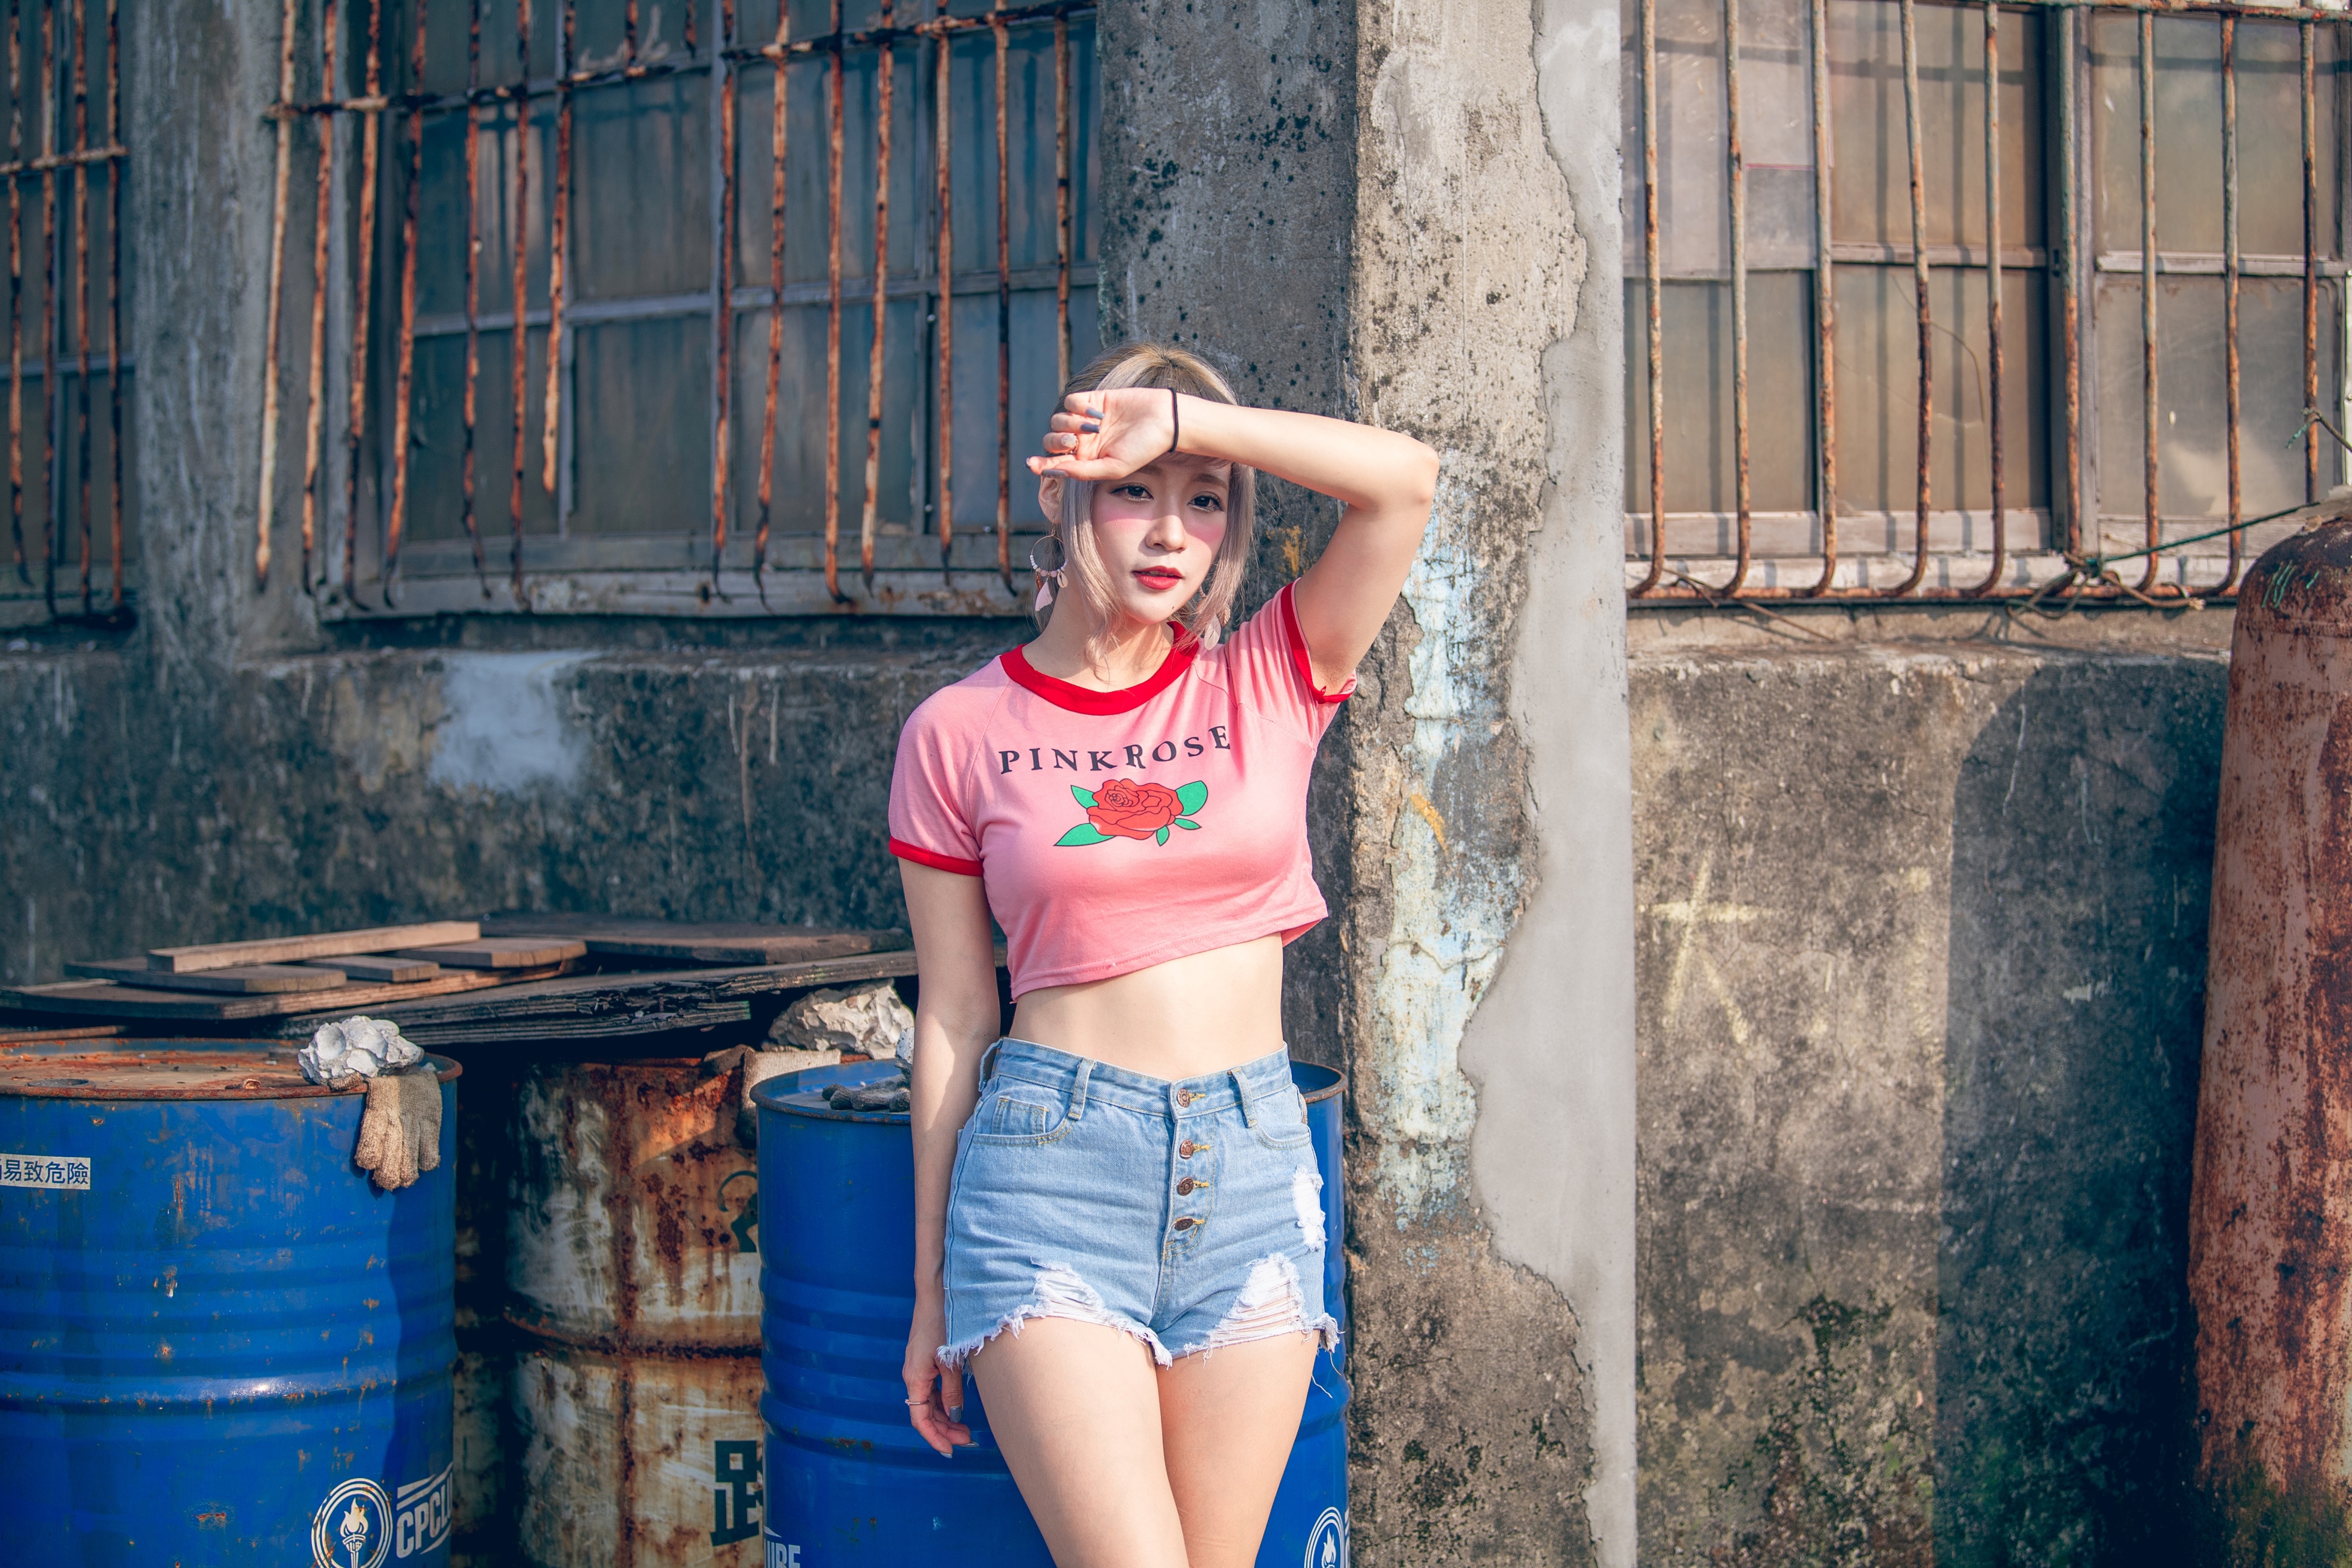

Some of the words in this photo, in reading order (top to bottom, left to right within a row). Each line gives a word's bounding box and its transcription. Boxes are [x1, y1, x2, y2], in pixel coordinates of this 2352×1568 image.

[998, 726, 1231, 774] PINKROSE
[0, 1159, 89, 1184] 易致危險
